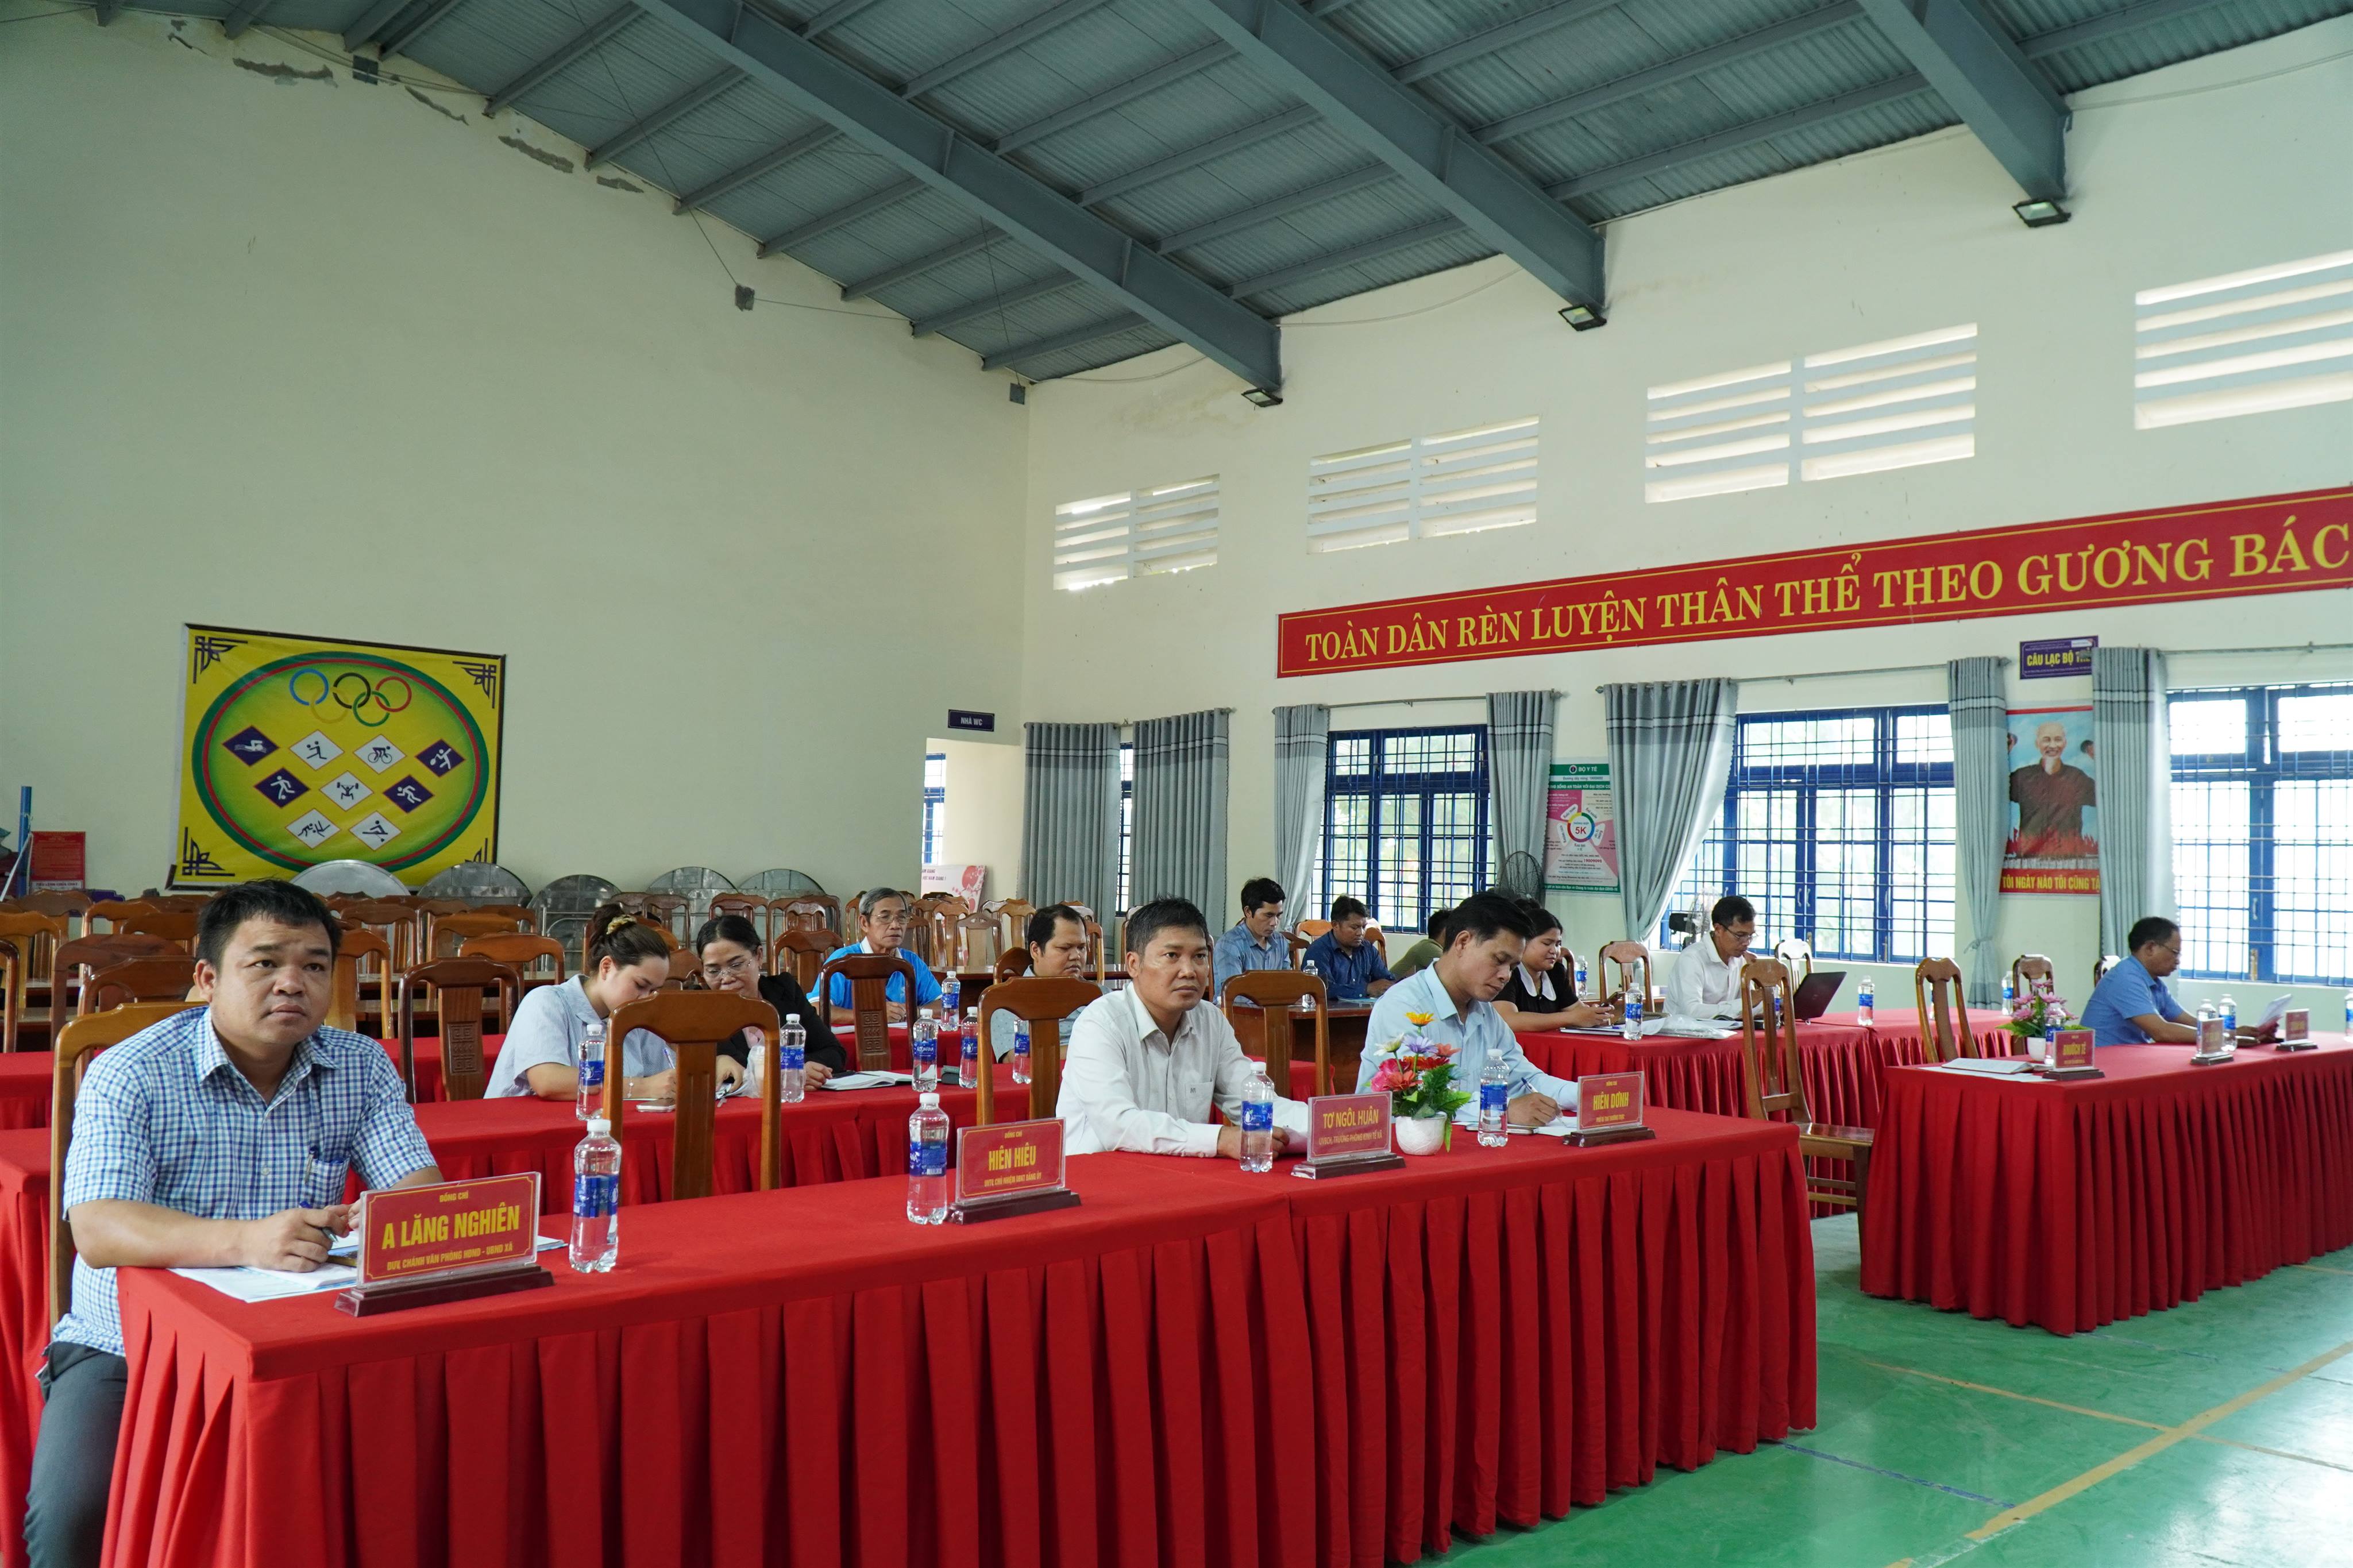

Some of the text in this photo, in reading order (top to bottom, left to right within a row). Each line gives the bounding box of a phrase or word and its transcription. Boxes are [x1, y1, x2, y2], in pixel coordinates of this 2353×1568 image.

[1306, 515, 2350, 661] TOÀN DÂN RÈN LUYỆN THÂN THỂ THEO GƯƠNG BÁC
[2027, 652, 2043, 666] CÂU
[2045, 652, 2061, 667] LẠC
[2062, 650, 2074, 665] BỘ
[961, 717, 983, 726] NHÀ WC
[381, 1202, 520, 1250] A LĂNG NGHIÊN
[402, 1256, 425, 1268] CHÁNH
[426, 1253, 439, 1264] VĂN
[440, 1250, 462, 1262] PHÒNG
[486, 1243, 504, 1255] UBND
